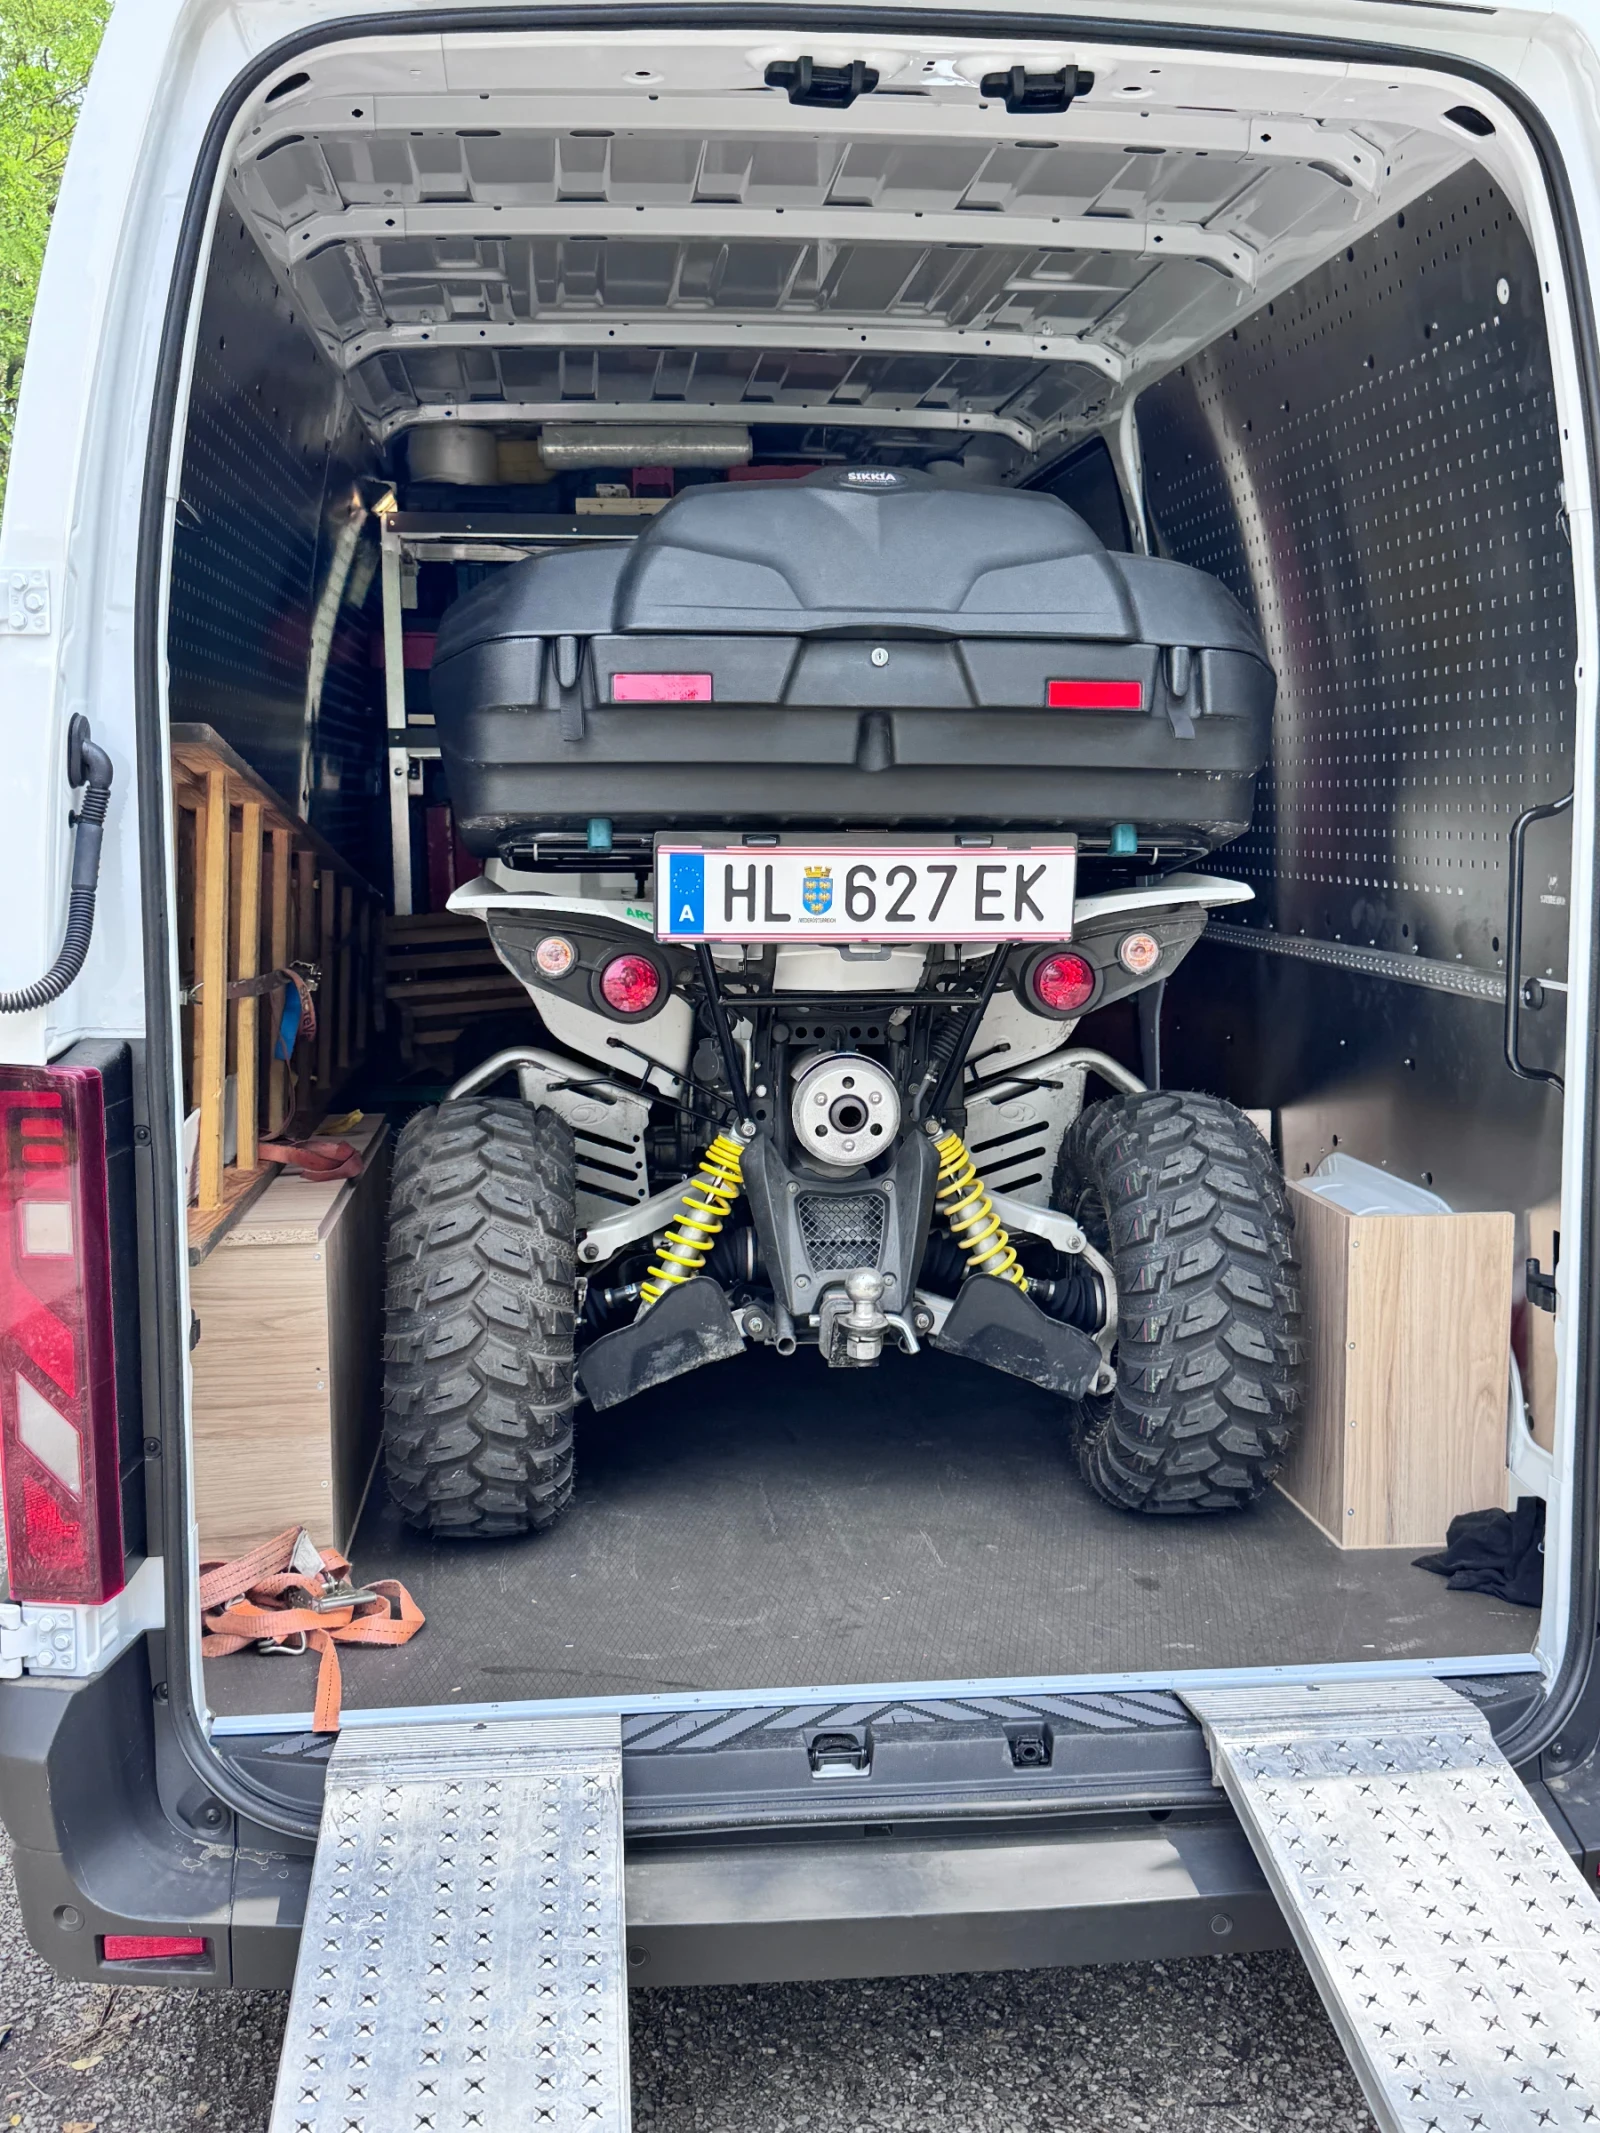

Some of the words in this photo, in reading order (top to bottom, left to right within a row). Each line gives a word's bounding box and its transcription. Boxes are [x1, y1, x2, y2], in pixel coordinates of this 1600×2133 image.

[848, 472, 896, 481] SIKKIA
[724, 864, 791, 922] HL
[845, 864, 957, 922] 627
[974, 864, 1046, 922] EK
[678, 904, 695, 922] A
